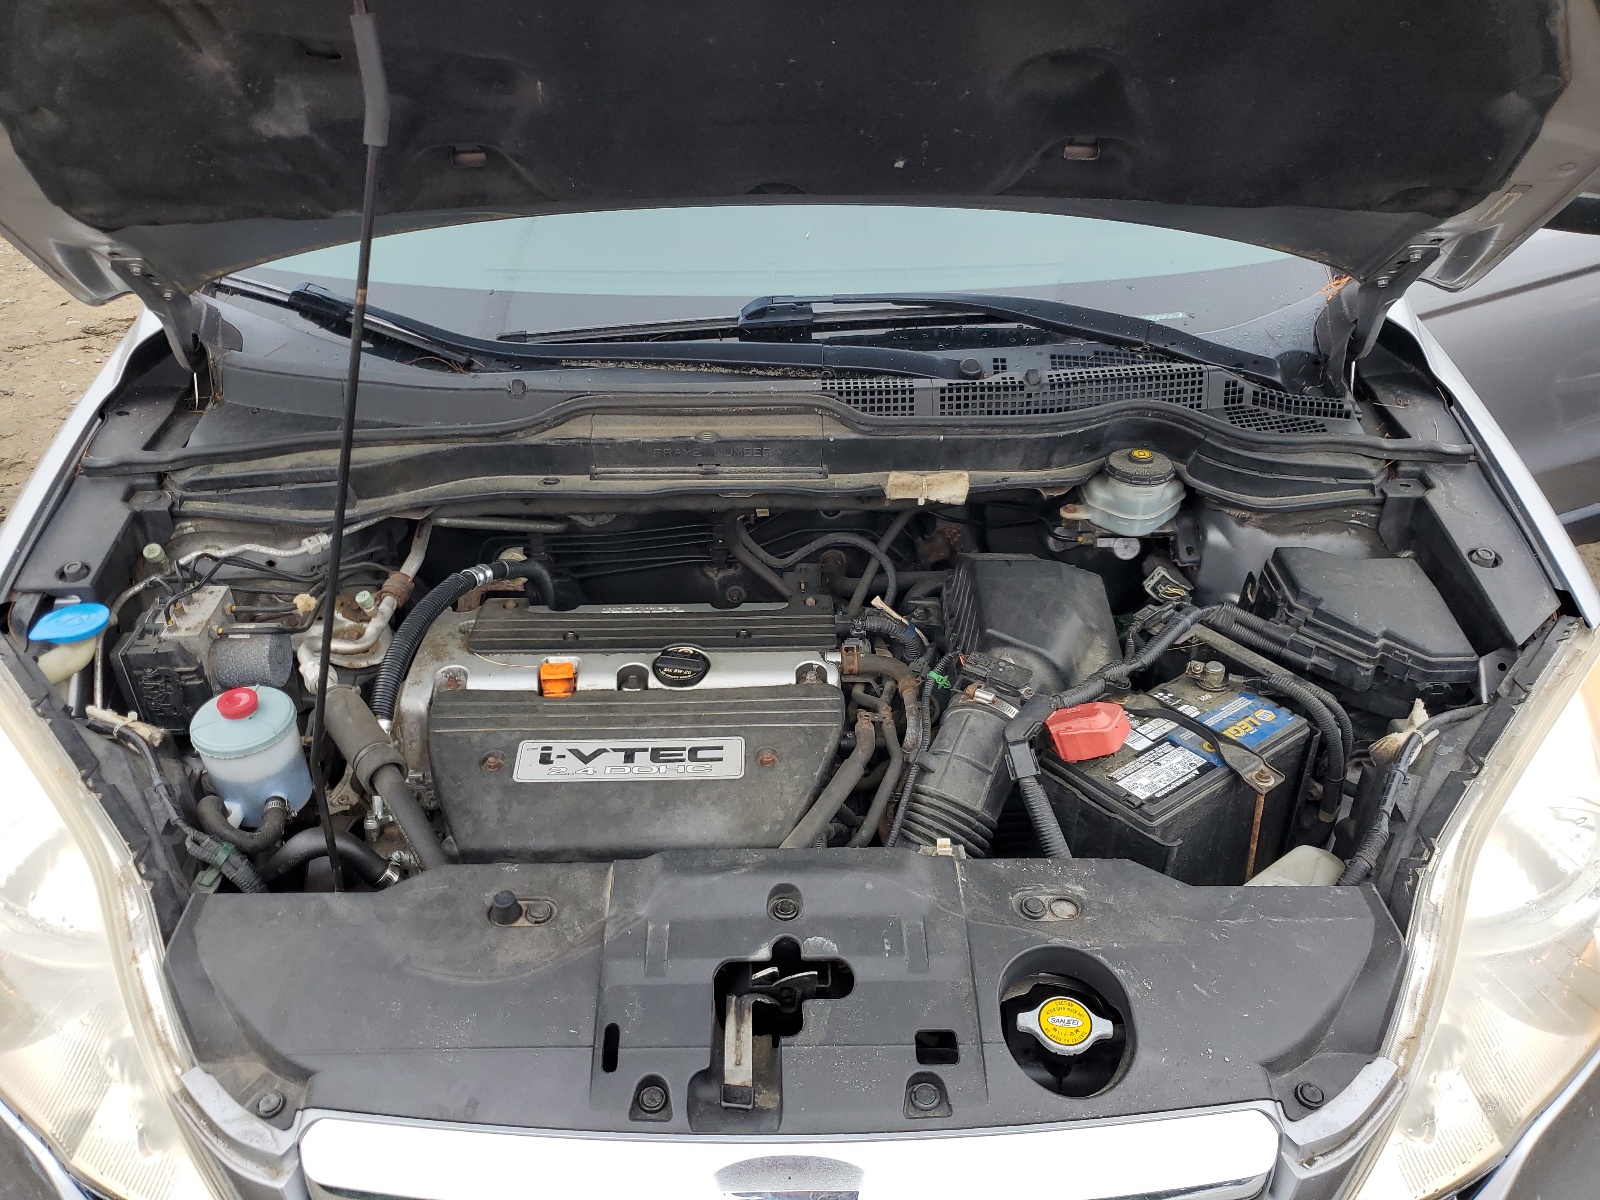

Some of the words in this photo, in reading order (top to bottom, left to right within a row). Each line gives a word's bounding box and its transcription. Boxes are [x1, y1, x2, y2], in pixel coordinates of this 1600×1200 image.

[653, 447, 702, 458] FRAME
[714, 446, 772, 459] NUMBER
[539, 746, 724, 765] i-VTEC
[547, 766, 597, 776] 2.4
[604, 764, 713, 775] DOHC
